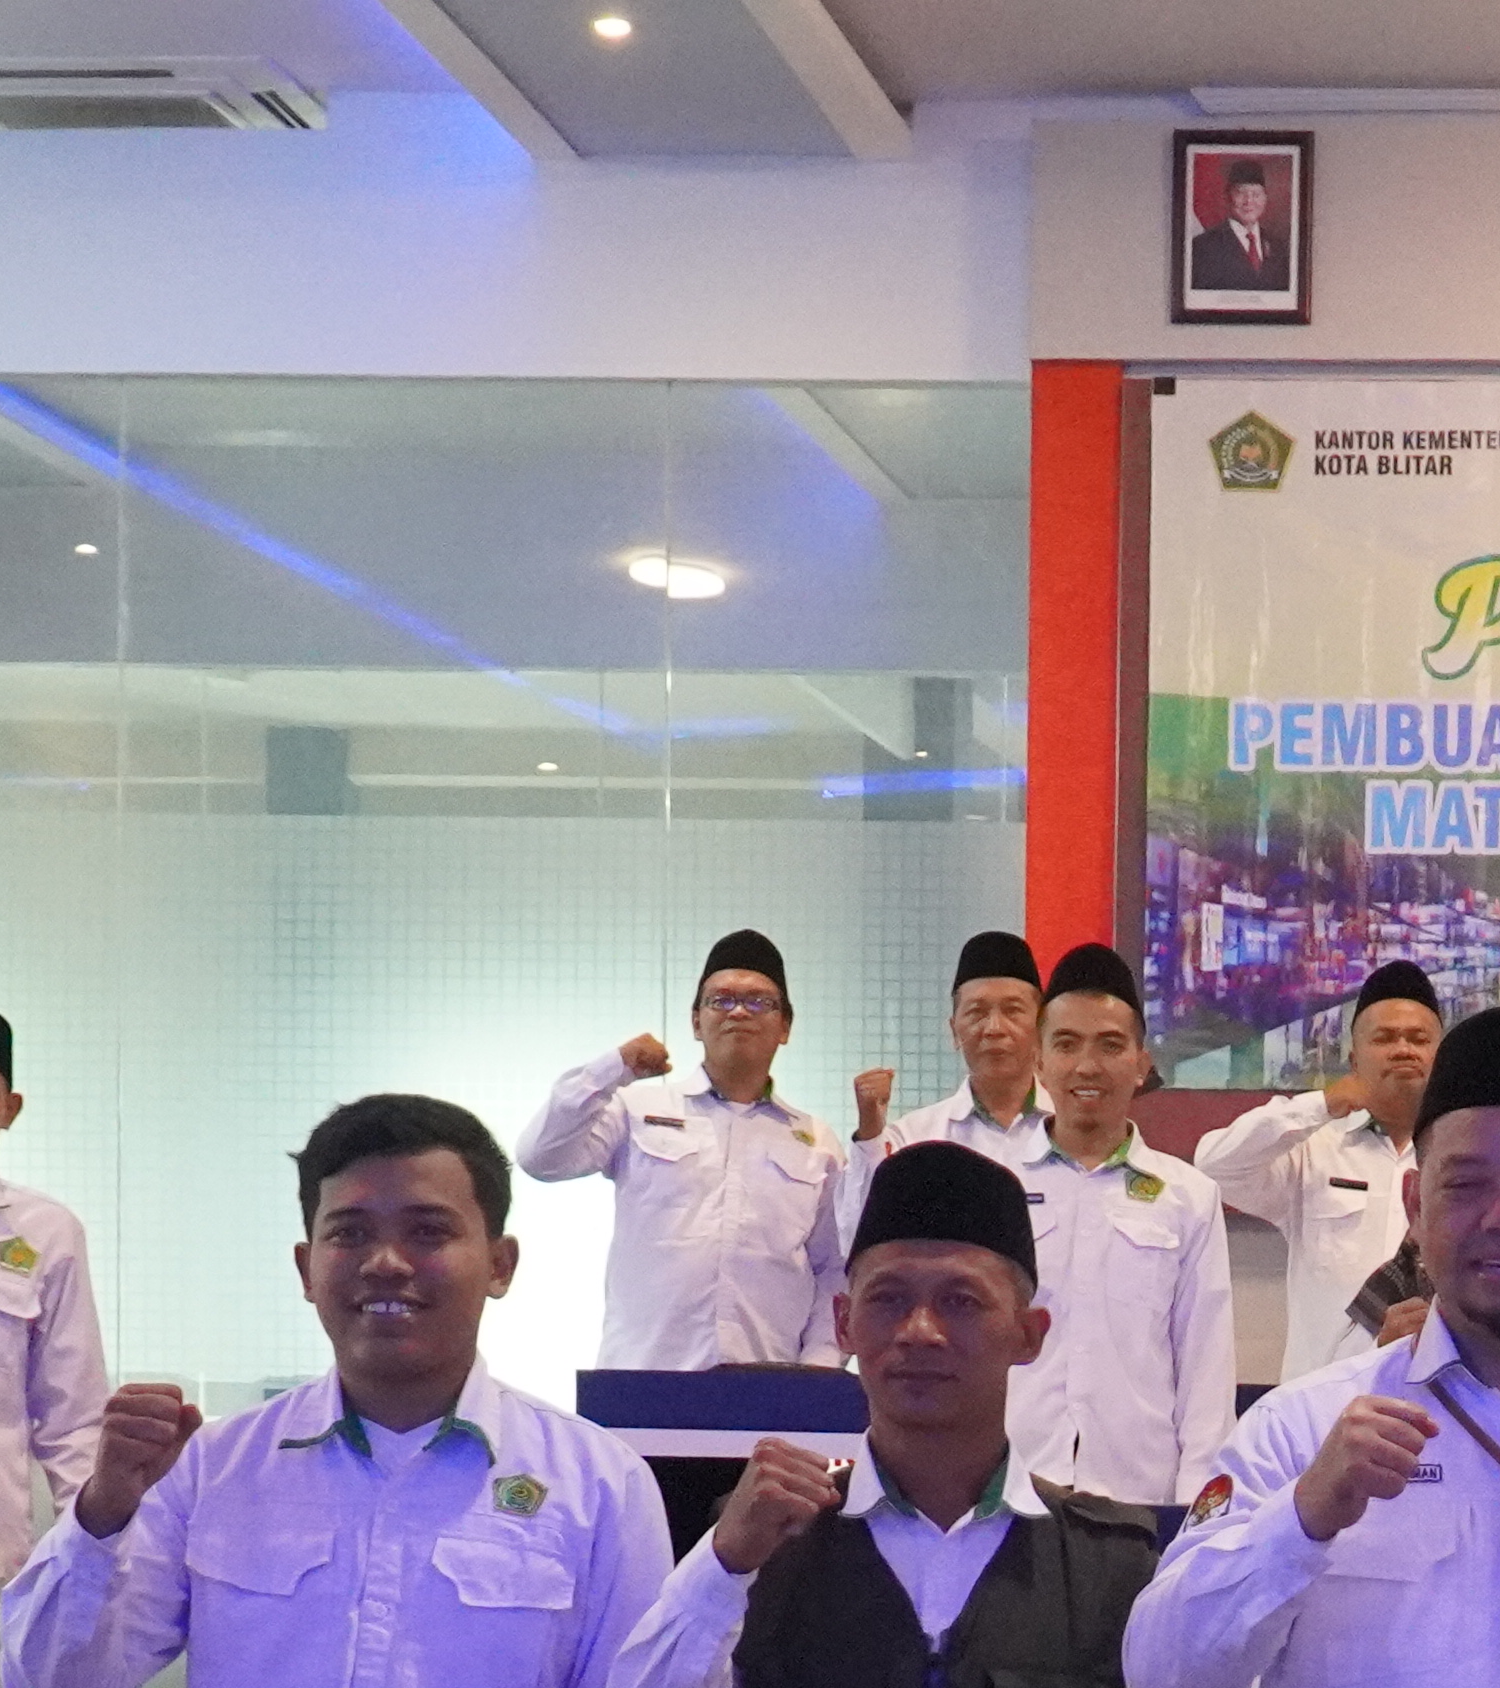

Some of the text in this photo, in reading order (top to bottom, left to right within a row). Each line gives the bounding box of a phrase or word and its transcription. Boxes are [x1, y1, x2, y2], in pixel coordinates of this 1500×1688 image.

[1314, 429, 1395, 451] KANTOR
[1314, 454, 1453, 476] KOTA BLITAR
